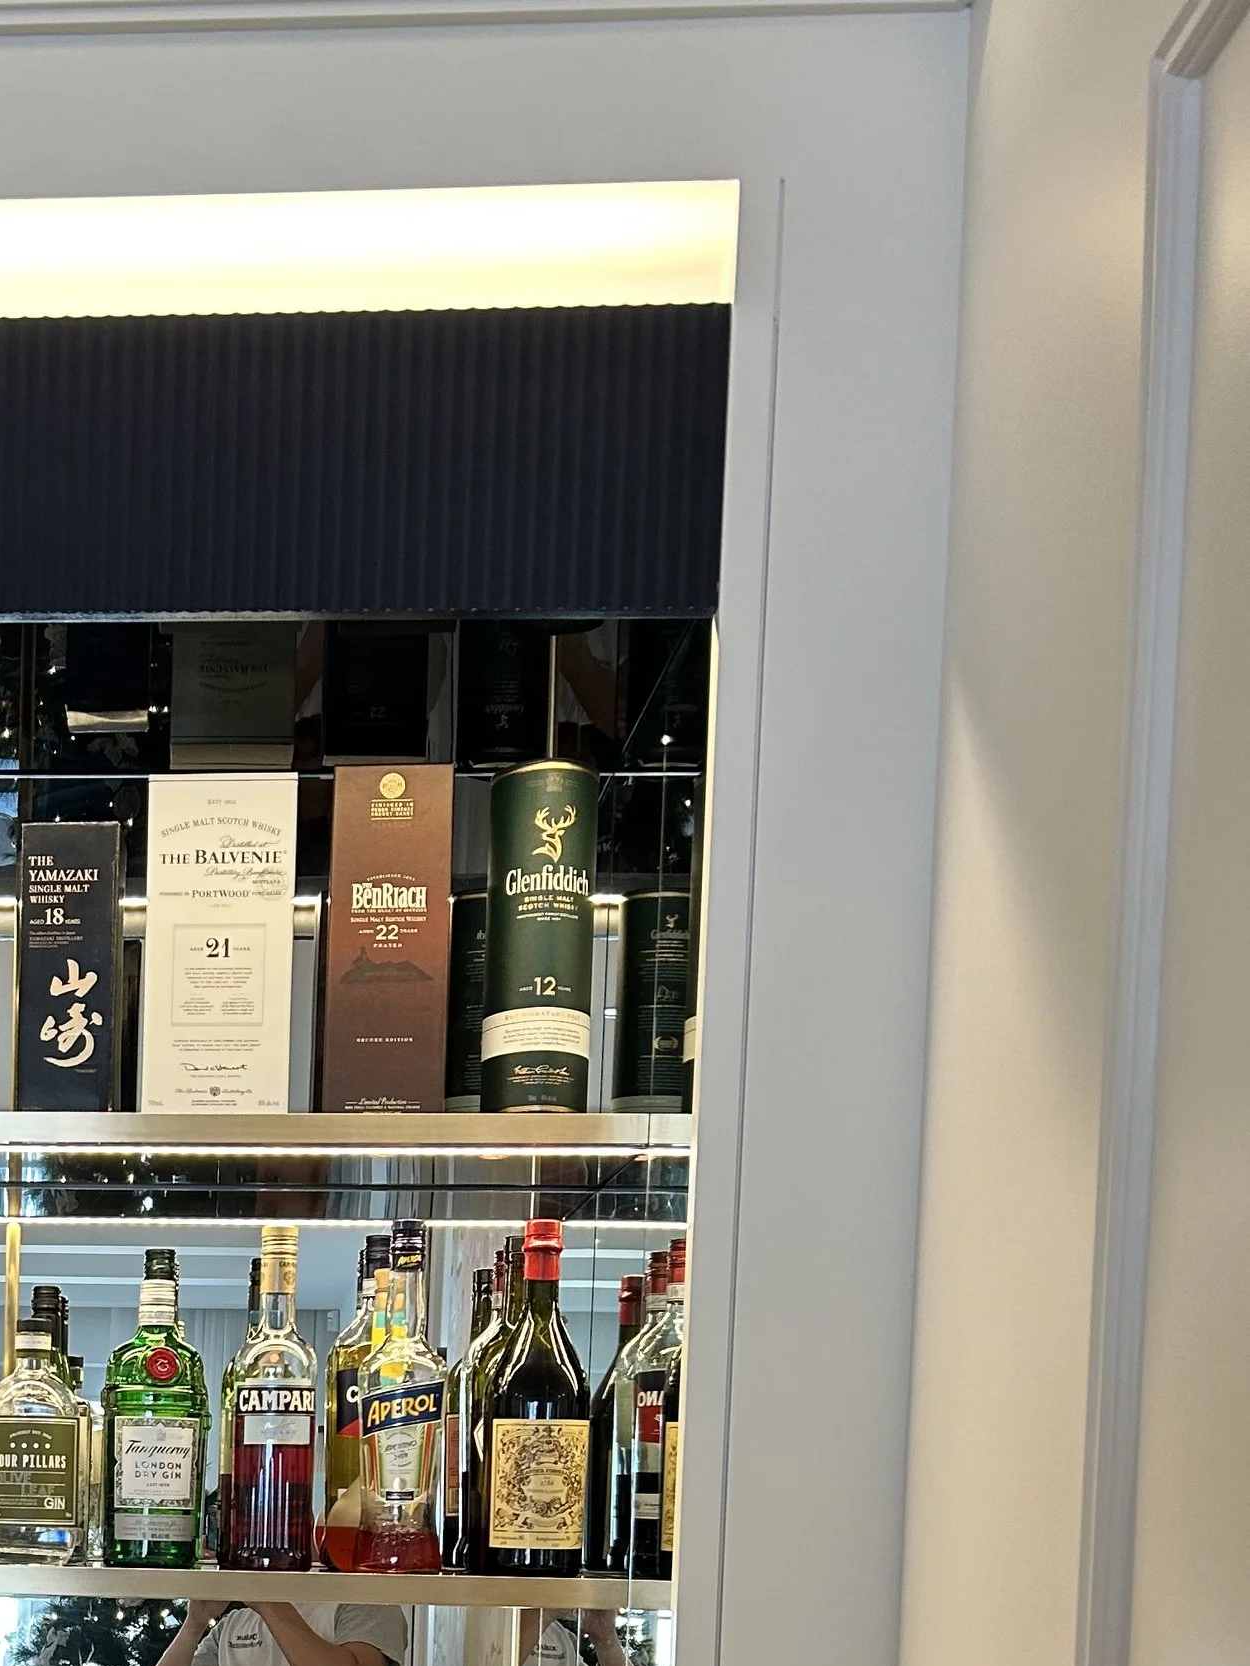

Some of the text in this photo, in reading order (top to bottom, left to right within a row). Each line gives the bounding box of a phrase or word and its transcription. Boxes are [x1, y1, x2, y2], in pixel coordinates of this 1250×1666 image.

[161, 816, 282, 838] SINGLE MALT SCOTCH WHISKY
[28, 855, 54, 867] THE
[159, 849, 282, 865] THE BALVENIE
[28, 869, 99, 882] YAMAZAKI
[505, 864, 589, 897] Glenfiddich
[29, 883, 90, 893] SINGLE MALT
[29, 895, 65, 904] WHISKY
[518, 903, 550, 911] SCOTCH
[44, 907, 65, 926] 18
[375, 924, 399, 940] 22
[205, 937, 230, 958] 21
[533, 976, 557, 996] 12
[239, 1388, 315, 1412] CAMPARI
[367, 1393, 438, 1428] APEROL
[125, 1440, 191, 1459] Tanqueray
[22, 1454, 66, 1469] PILLARS
[135, 1461, 182, 1470] LONDON
[162, 1471, 182, 1479] GIN
[21, 1485, 55, 1497] LEAF
[44, 1496, 66, 1510] GIN
